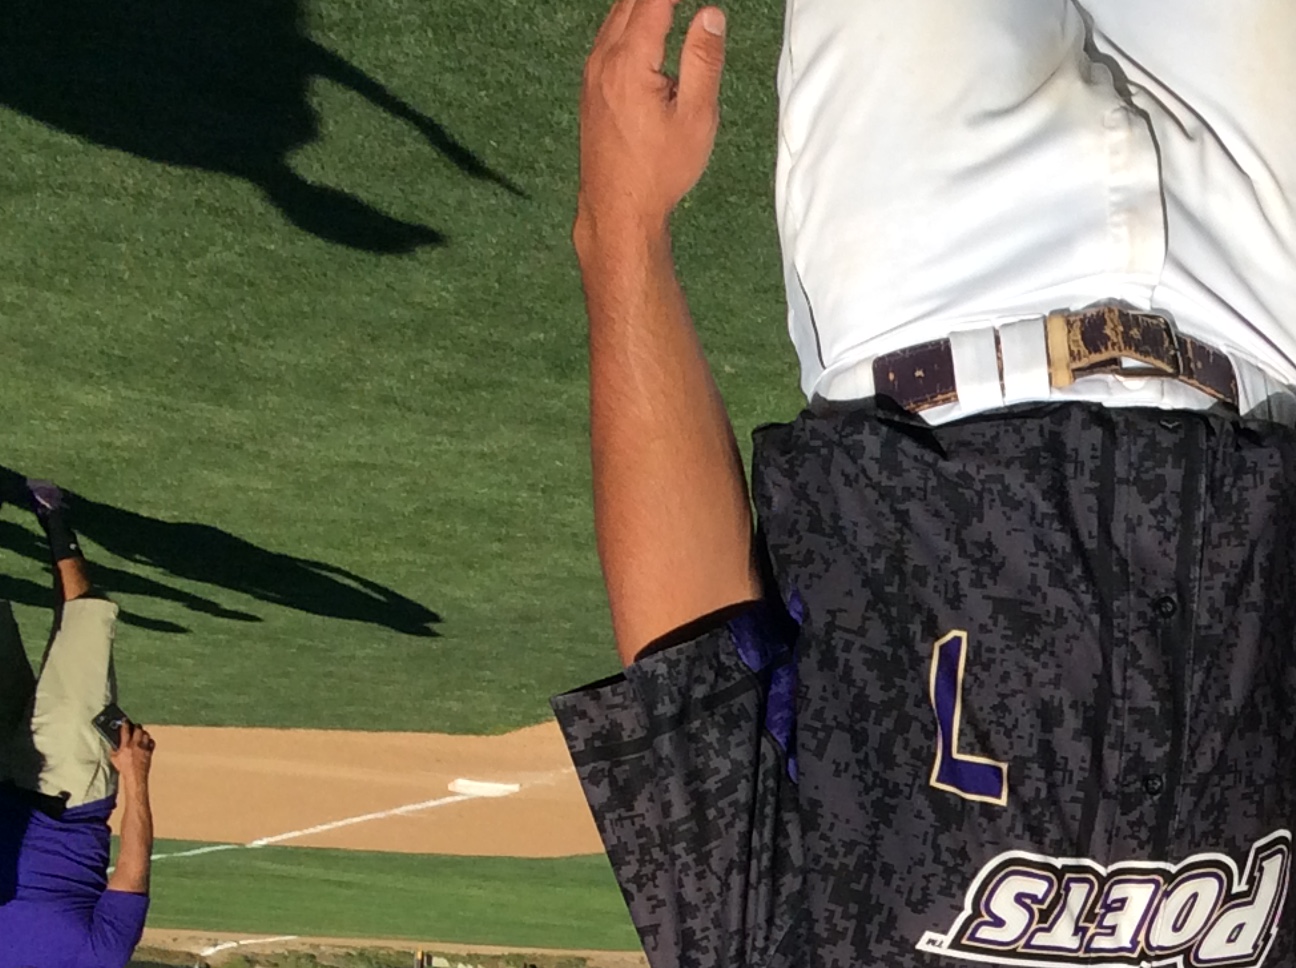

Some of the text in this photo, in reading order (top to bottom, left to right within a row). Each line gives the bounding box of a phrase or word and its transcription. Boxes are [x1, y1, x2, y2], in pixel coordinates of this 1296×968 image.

[929, 630, 1008, 806] 7
[925, 844, 1288, 966] POETS TM
